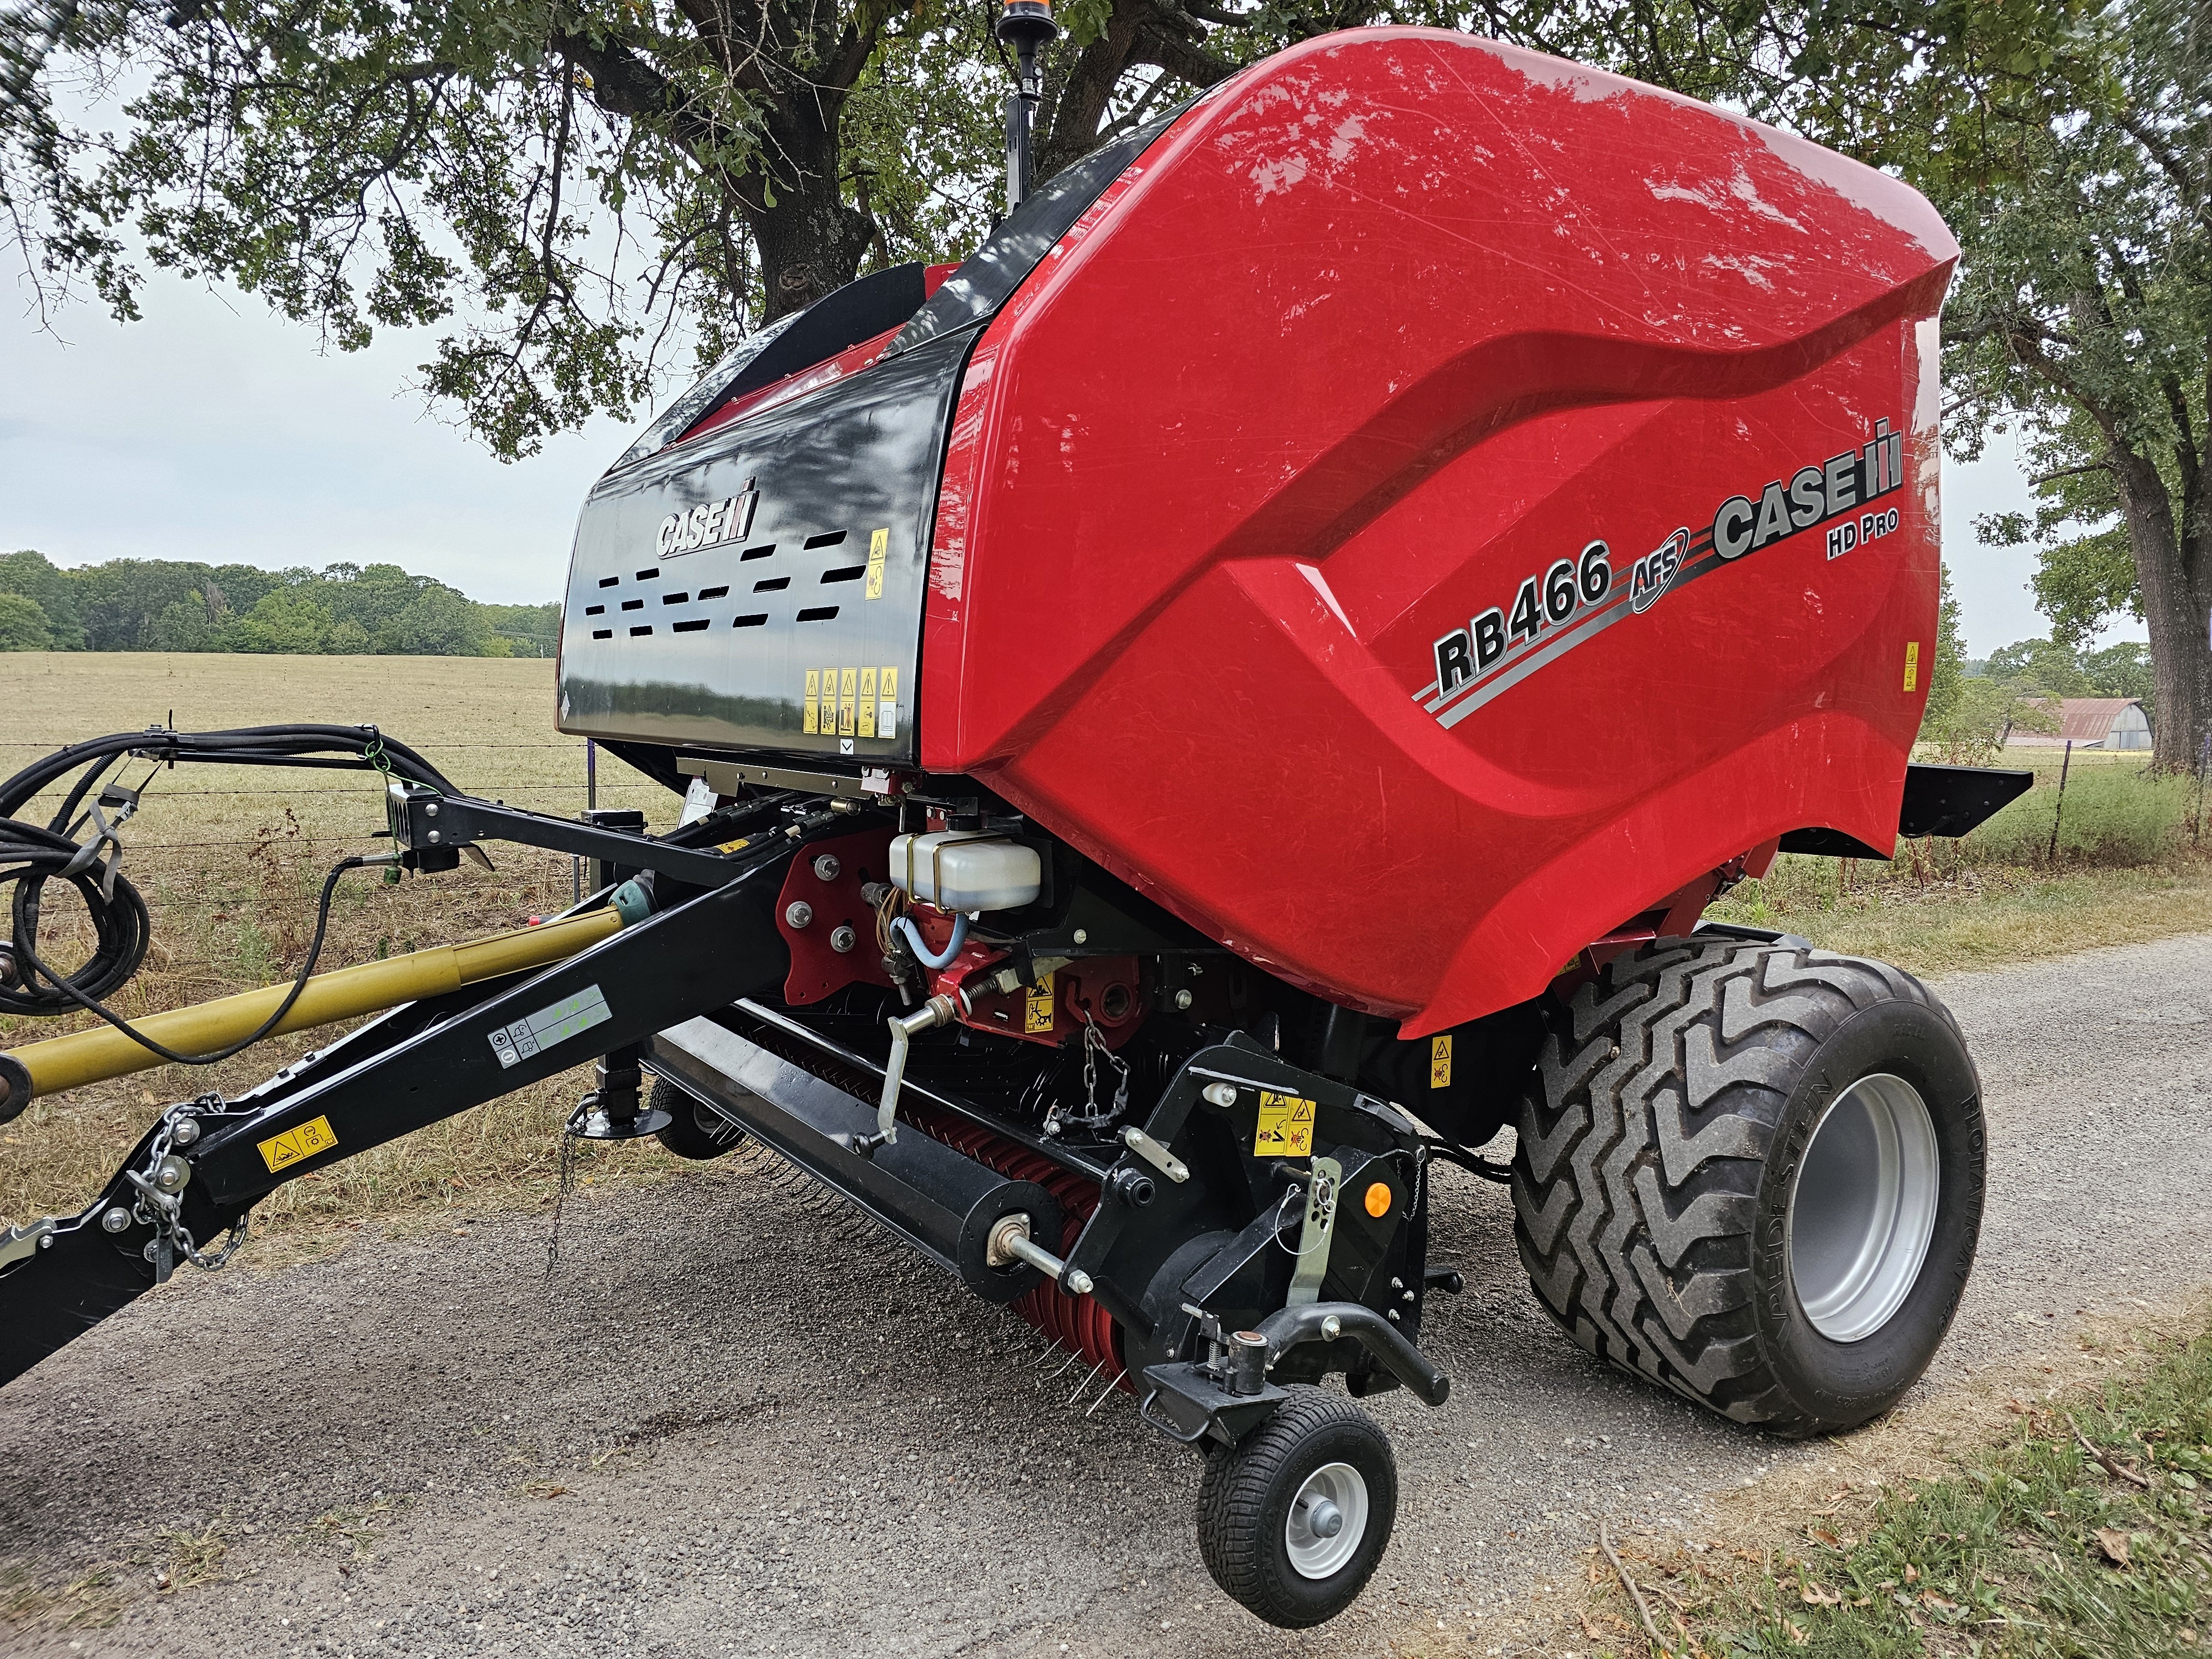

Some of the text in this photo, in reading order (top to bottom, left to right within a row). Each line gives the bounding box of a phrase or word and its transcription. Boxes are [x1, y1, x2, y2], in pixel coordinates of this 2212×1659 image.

[656, 499, 728, 557] CASE
[1714, 453, 1856, 559] CASE
[1826, 521, 1857, 561] HD
[1629, 539, 1678, 602] AFS
[1433, 539, 1611, 700] RB466
[1953, 1092, 1986, 1282] FLOTATION
